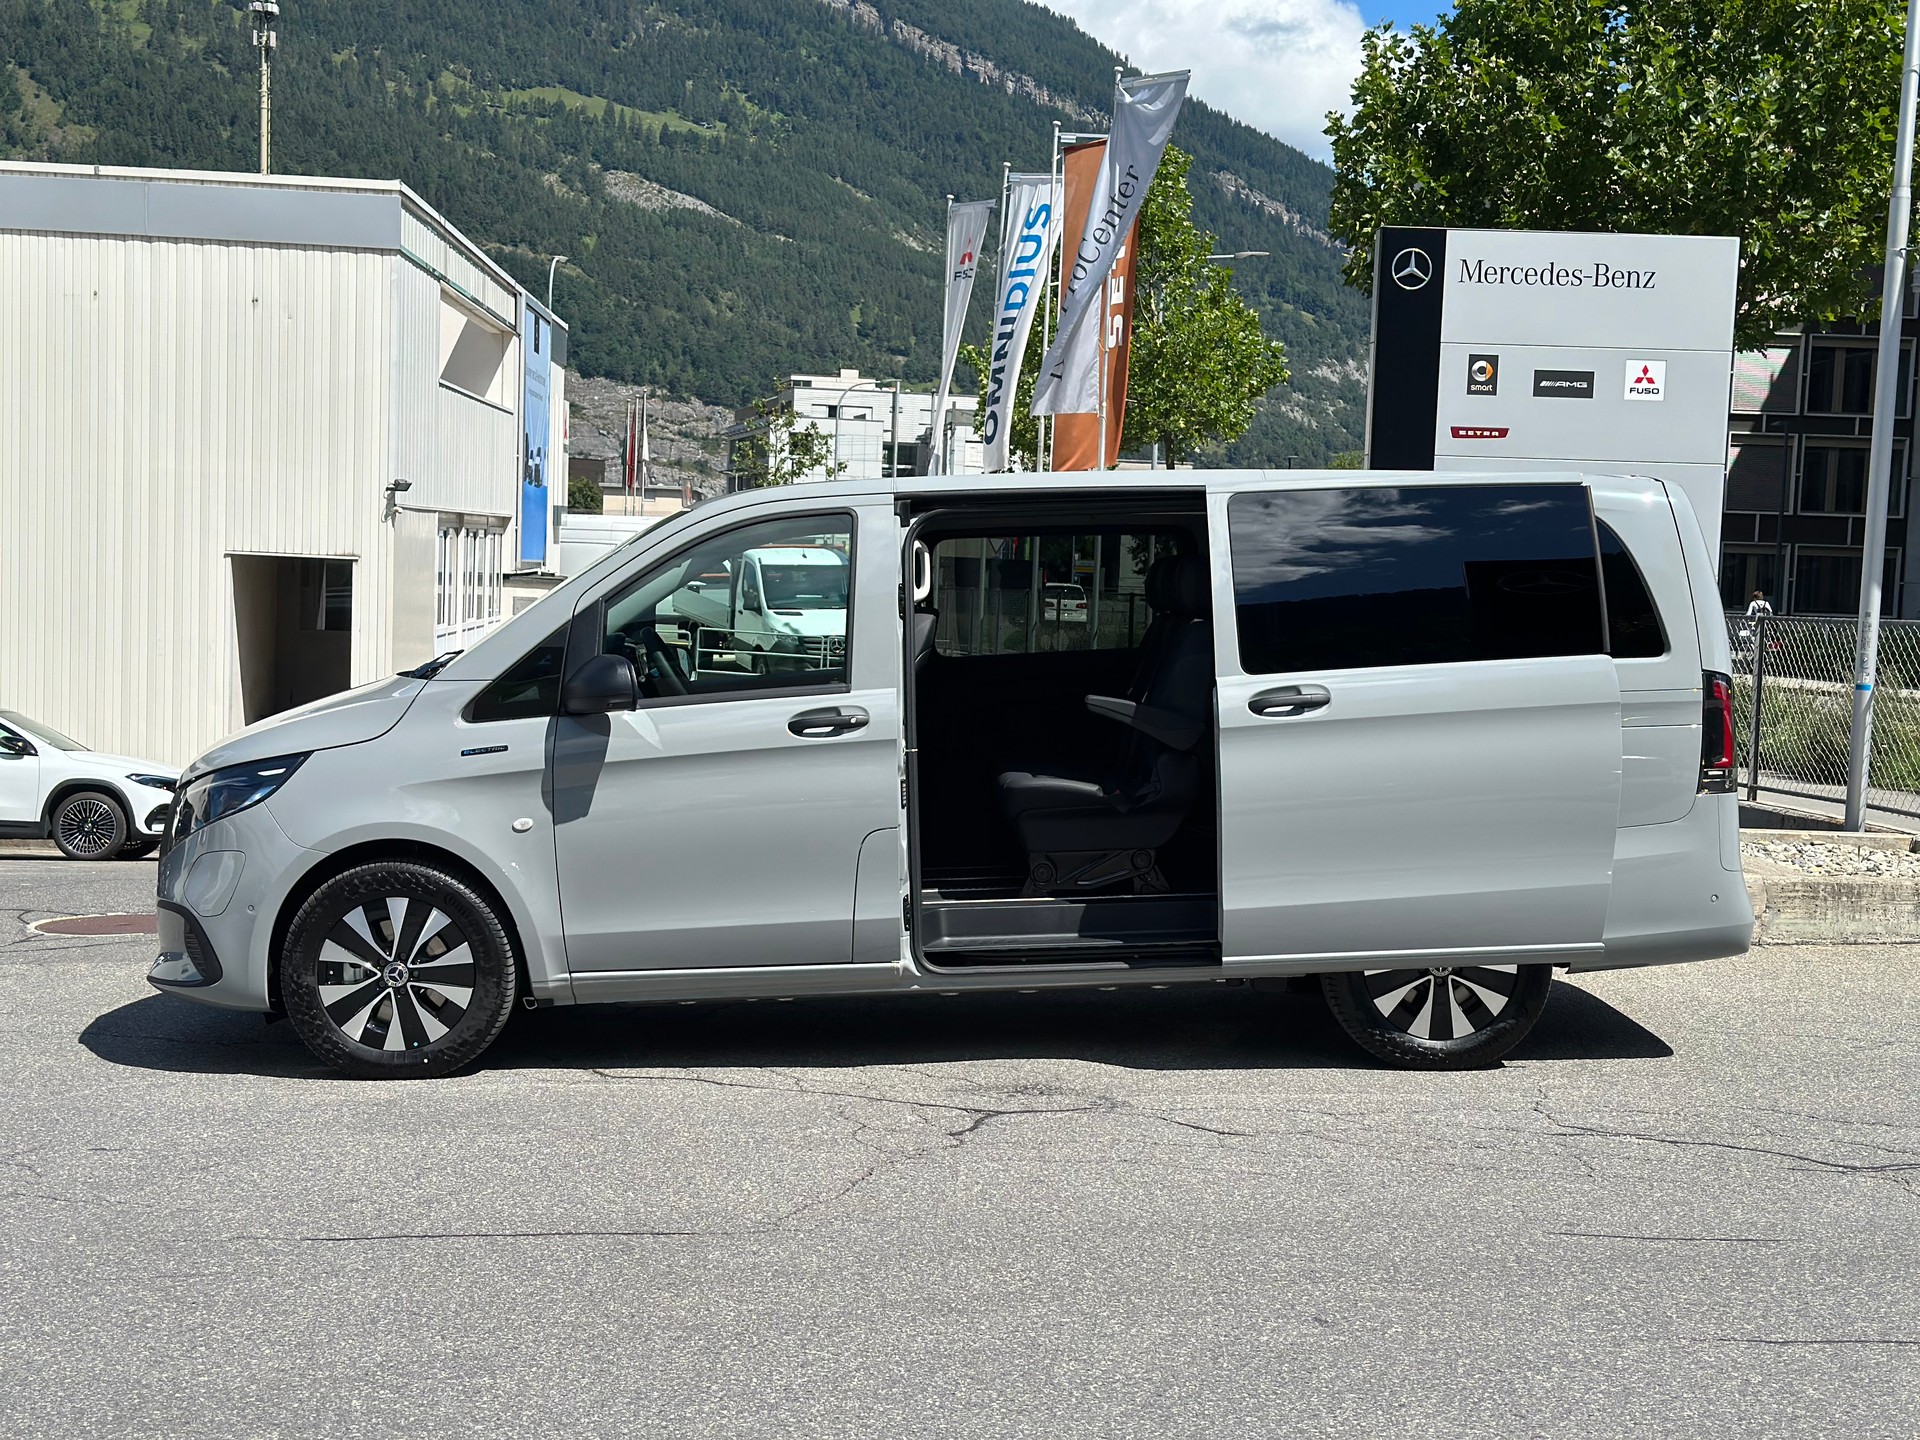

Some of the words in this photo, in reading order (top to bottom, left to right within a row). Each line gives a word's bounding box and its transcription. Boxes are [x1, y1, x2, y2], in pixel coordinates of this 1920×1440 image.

[1457, 258, 1657, 289] Mercedes-Benz
[1470, 384, 1493, 392] smart
[1554, 380, 1588, 388] AMG
[1629, 387, 1660, 395] FUSO
